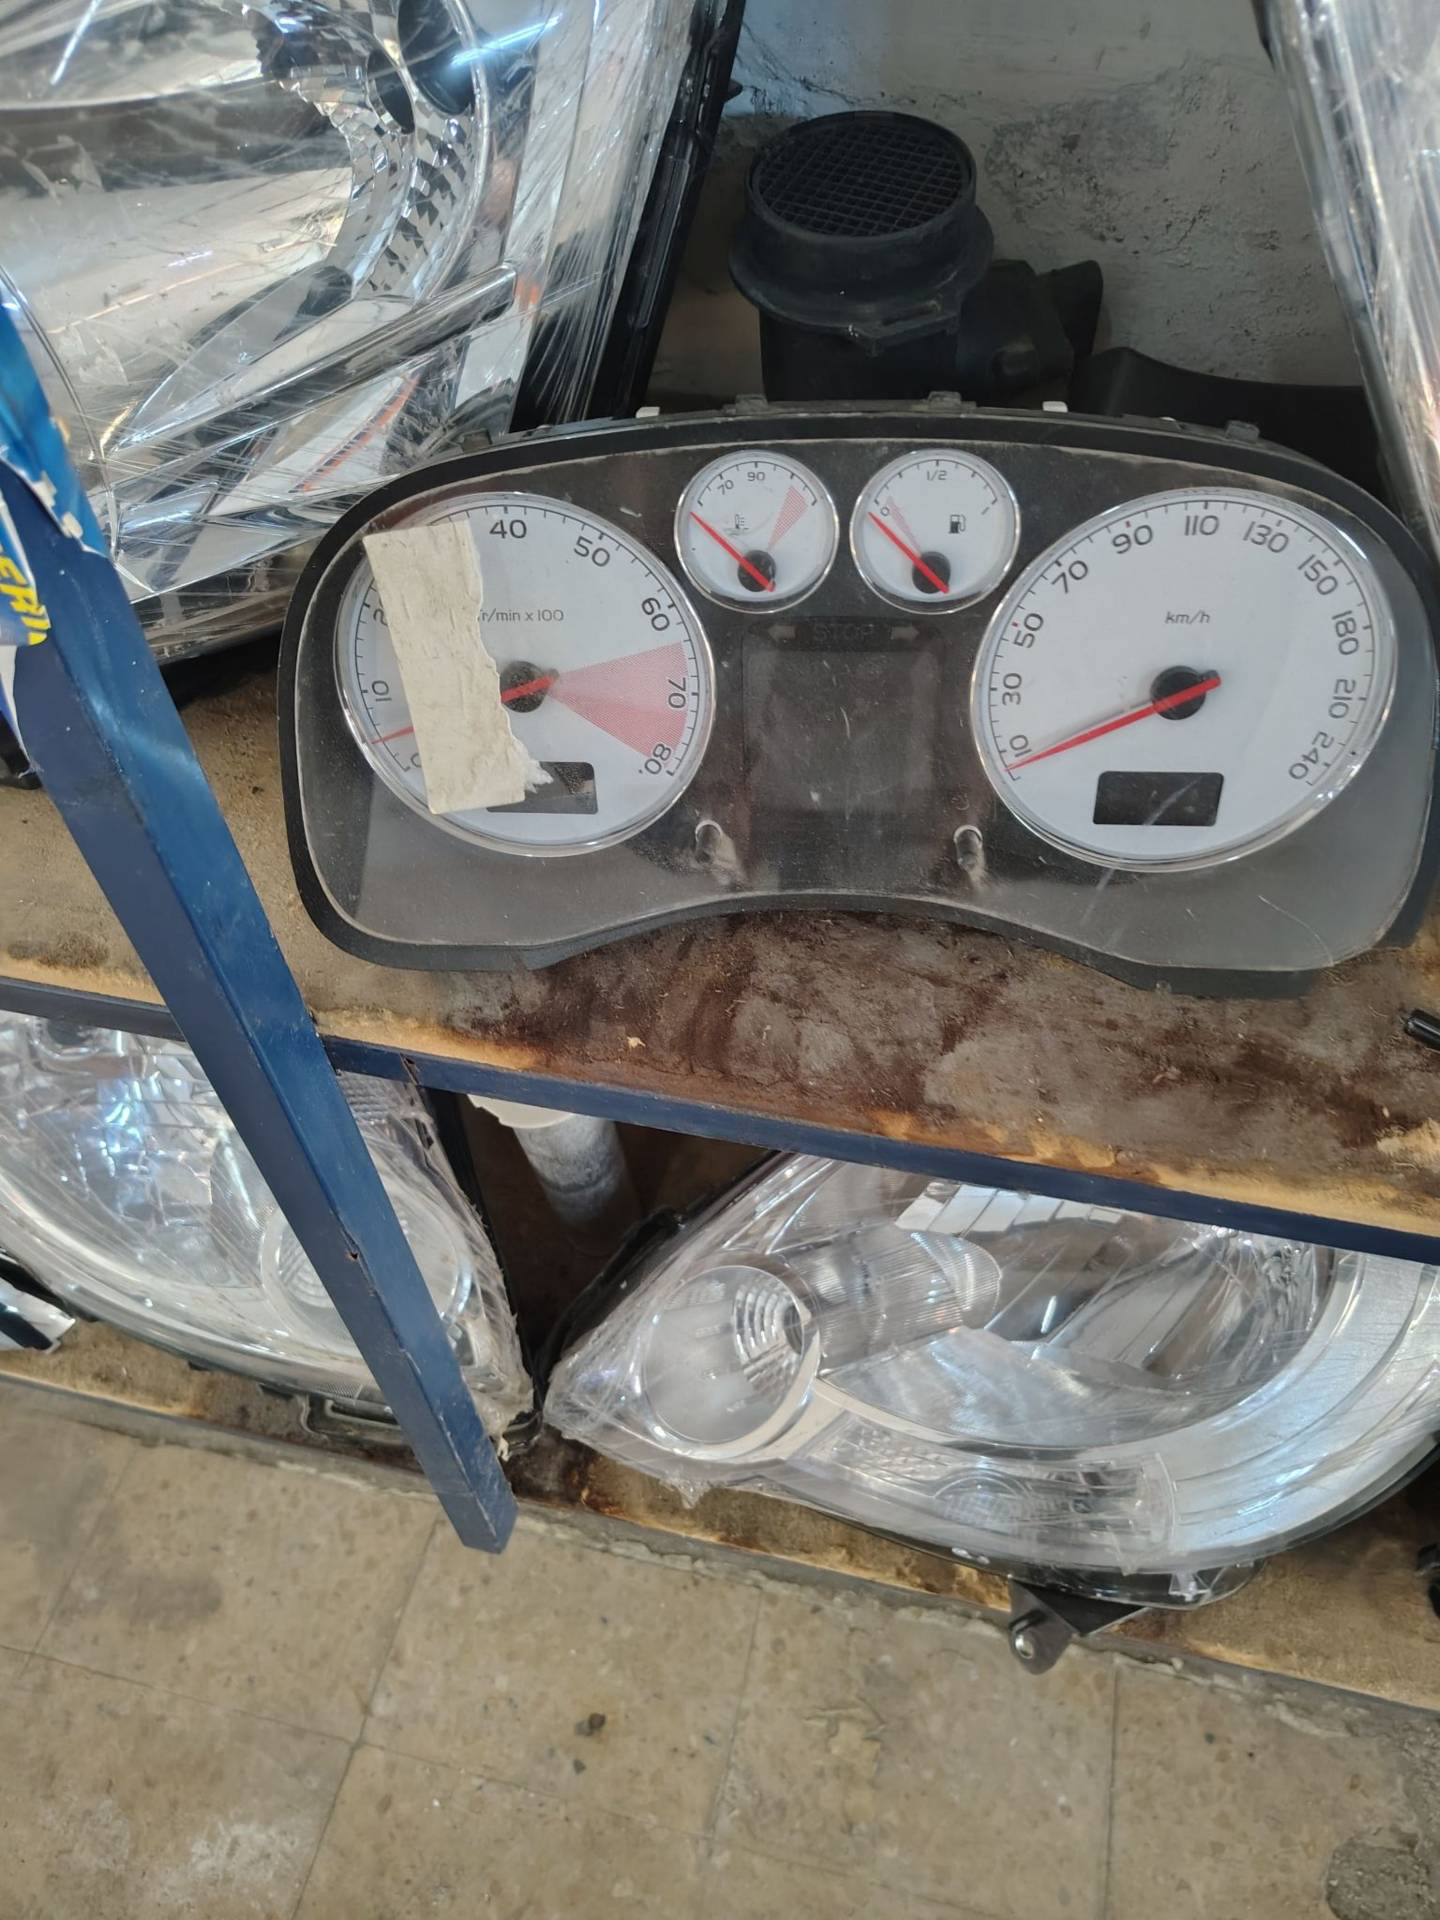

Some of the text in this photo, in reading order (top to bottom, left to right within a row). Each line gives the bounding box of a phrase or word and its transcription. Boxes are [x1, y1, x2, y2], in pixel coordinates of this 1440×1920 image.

[718, 480, 734, 495] 70
[746, 471, 765, 481] 90
[926, 470, 947, 480] 1/2
[489, 519, 527, 539] 40
[1111, 524, 1154, 555] 90
[1184, 515, 1219, 537] 110
[1242, 521, 1289, 553] 130
[574, 536, 611, 567] 50
[1051, 560, 1089, 594] 70
[1297, 554, 1338, 596] 150
[525, 611, 534, 621] x
[538, 609, 564, 621] 100
[641, 597, 670, 631] 60
[1165, 610, 1211, 625] km/h
[1013, 613, 1044, 649] 50
[1331, 610, 1359, 655] 180
[372, 680, 392, 702] 10
[668, 677, 687, 709] 70
[1002, 673, 1022, 706] 30
[1329, 678, 1356, 719] 210
[644, 743, 671, 775] 80
[1009, 735, 1032, 757] 10
[1288, 732, 1334, 781] 240
